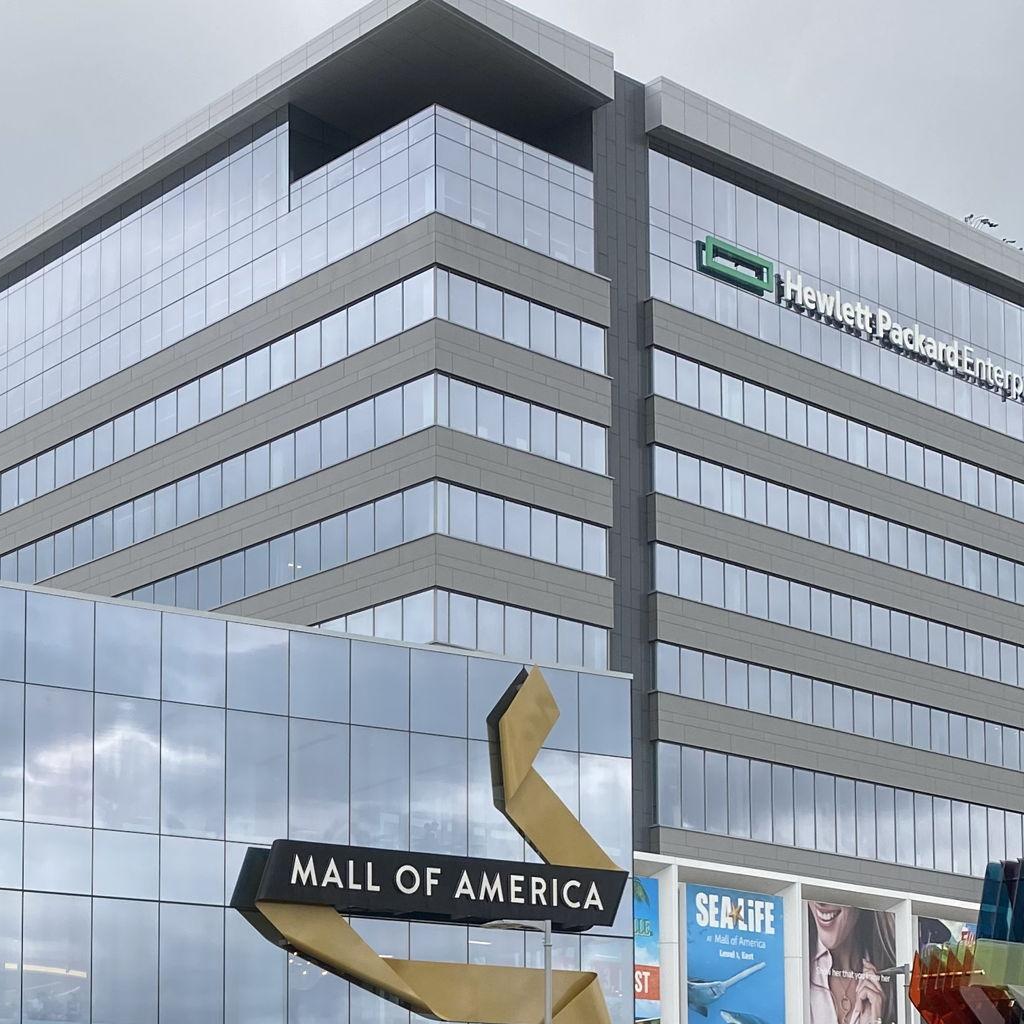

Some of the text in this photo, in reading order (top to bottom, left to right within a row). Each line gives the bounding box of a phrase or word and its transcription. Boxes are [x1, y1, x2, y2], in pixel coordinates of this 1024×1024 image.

[779, 270, 872, 334] Hewlett
[877, 308, 959, 368] Packard
[291, 853, 604, 911] MALL OF AMERICA
[696, 892, 734, 930] SEA
[714, 934, 729, 945] Mall
[730, 935, 738, 946] of
[739, 936, 766, 949] America
